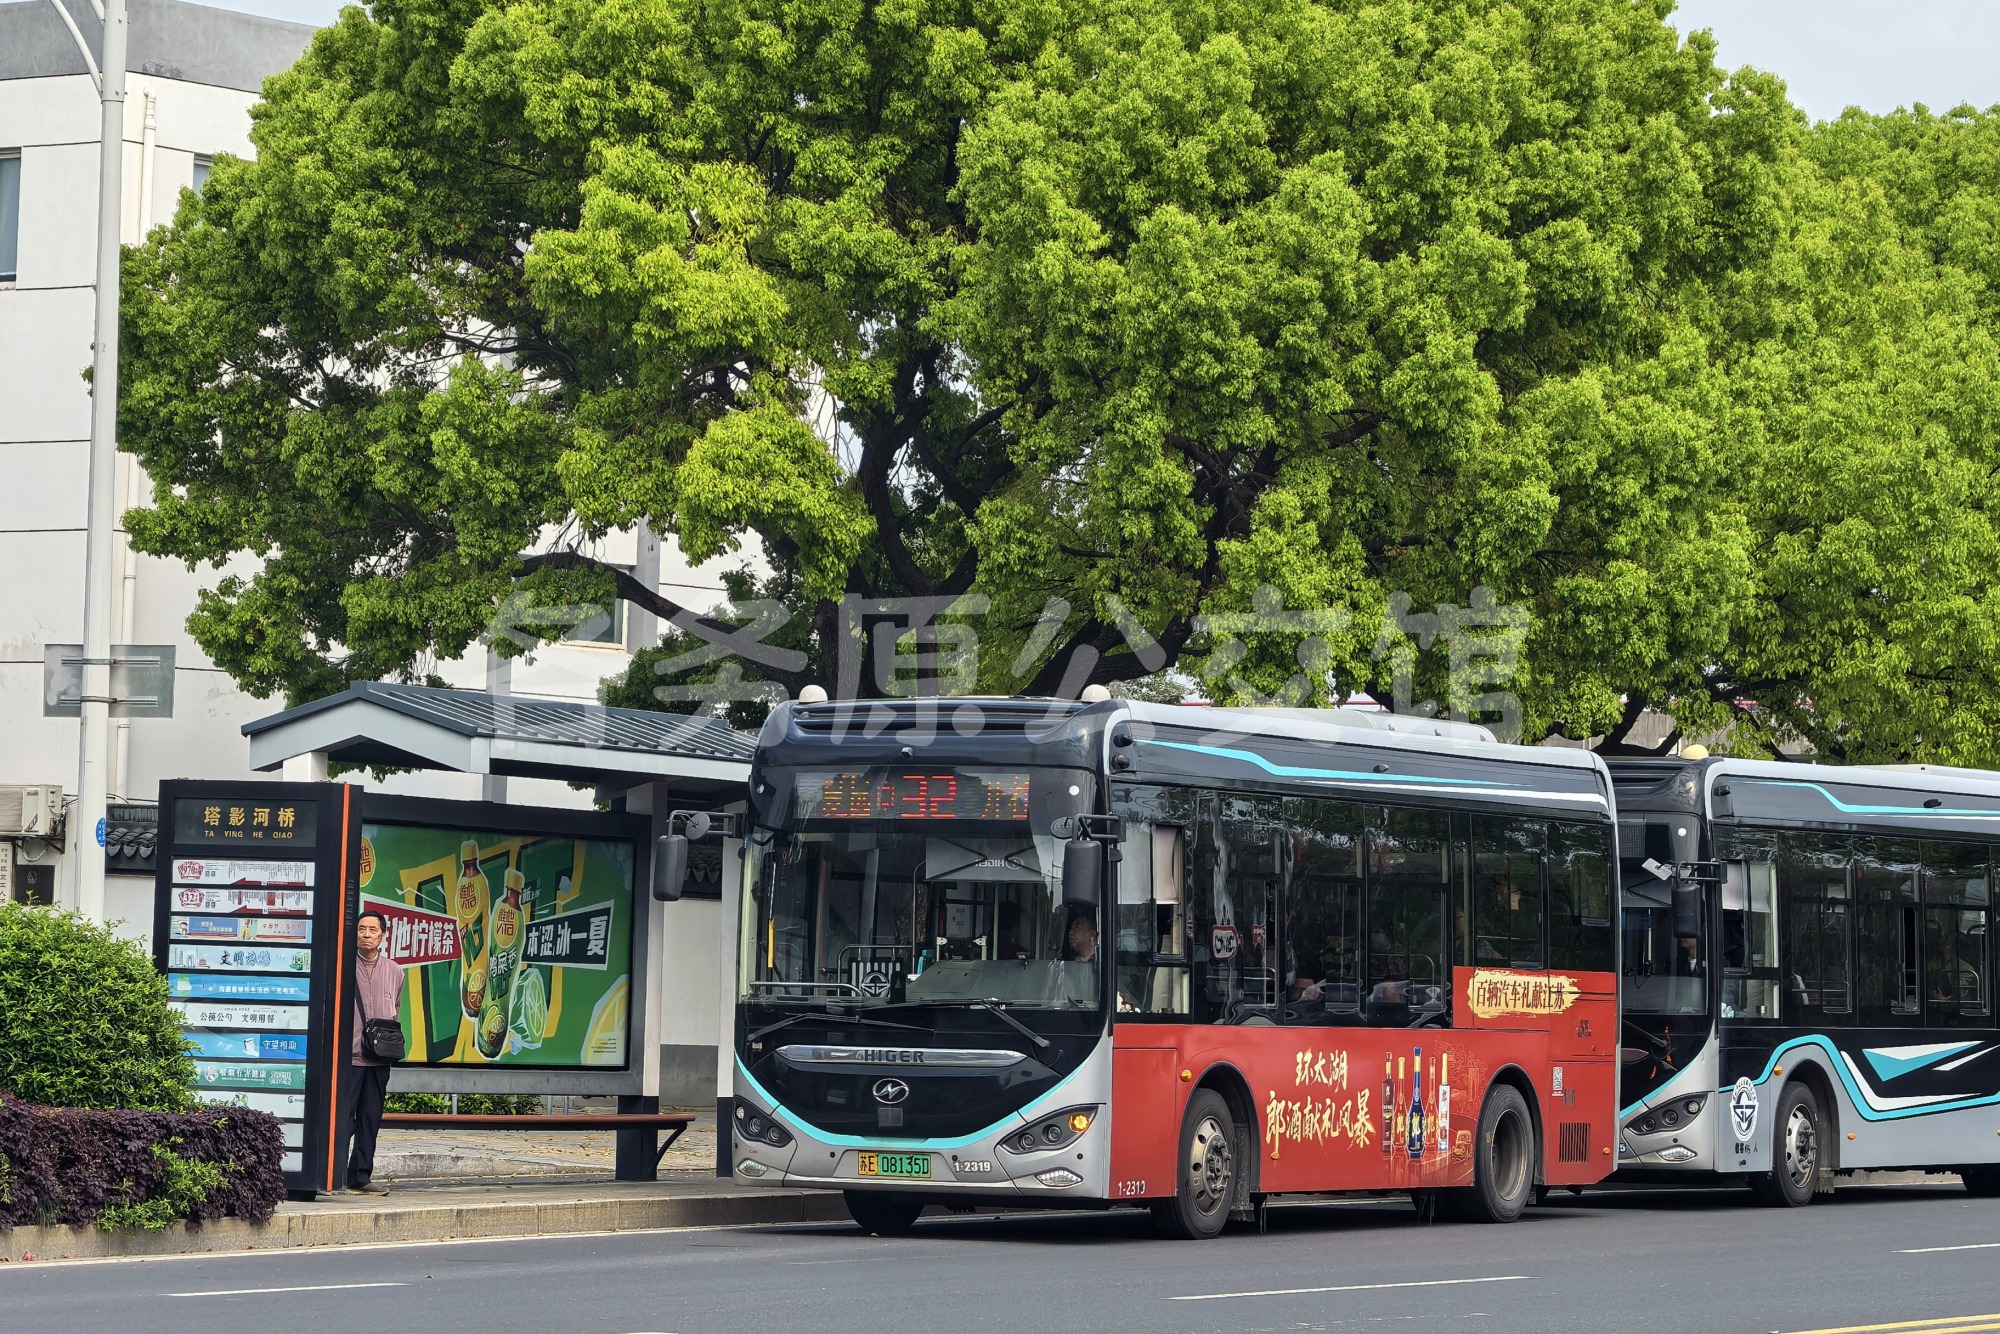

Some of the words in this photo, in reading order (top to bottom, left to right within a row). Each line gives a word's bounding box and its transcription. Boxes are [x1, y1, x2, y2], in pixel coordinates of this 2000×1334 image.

[900, 775, 957, 818] 32
[204, 806, 295, 828] 塔影河桥
[204, 830, 215, 838] TA
[272, 831, 293, 839] QIAO
[183, 893, 195, 903] 32
[1476, 979, 1566, 1010] 百辆汽车礼献江苏
[200, 1012, 233, 1022] 公筷公勺
[241, 1013, 275, 1024] 文明用餐
[263, 1040, 297, 1050] 守望相助
[864, 1048, 924, 1063] HIGER
[1295, 1048, 1349, 1093] 环太湖
[1265, 1088, 1376, 1153] 郎酒献礼风暴
[859, 1153, 876, 1173] 苏E
[881, 1155, 929, 1175] 08135D
[954, 1161, 991, 1173] 1-2319
[1118, 1181, 1146, 1196] 1-2319
